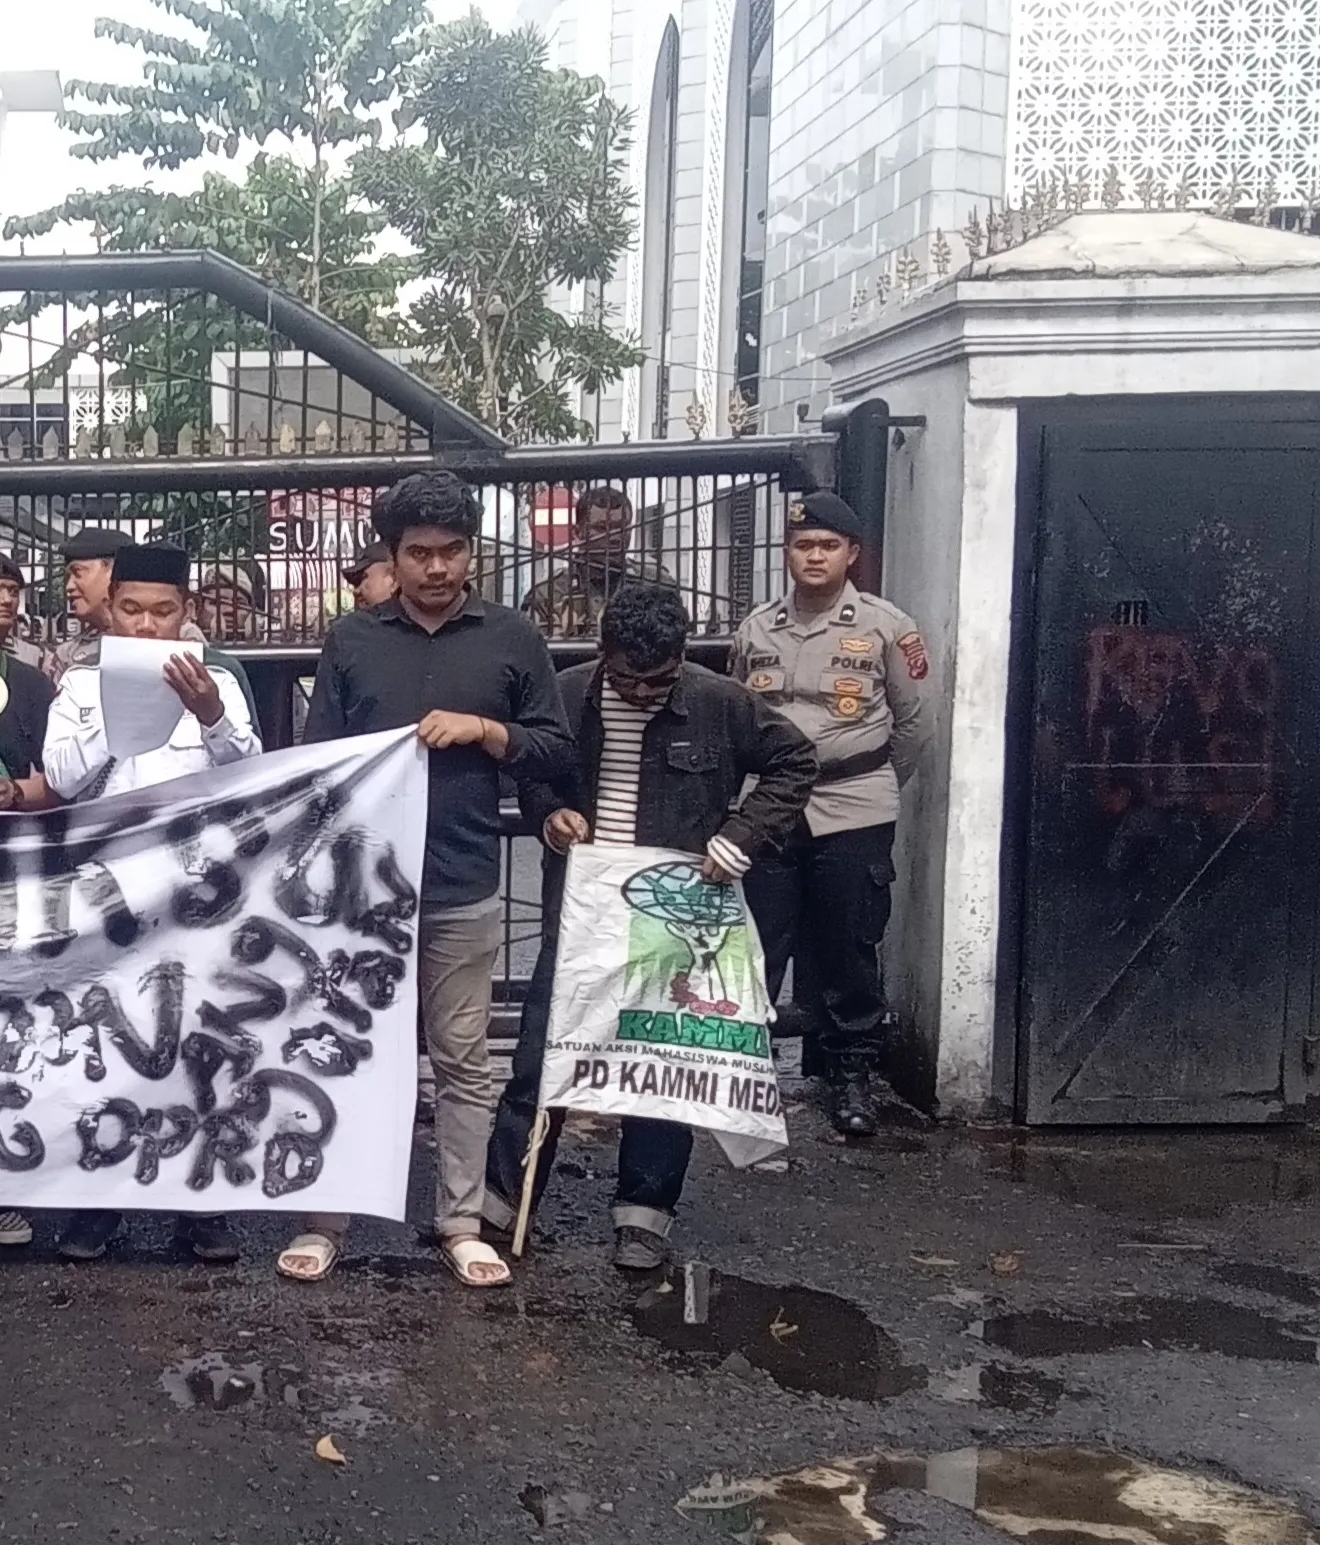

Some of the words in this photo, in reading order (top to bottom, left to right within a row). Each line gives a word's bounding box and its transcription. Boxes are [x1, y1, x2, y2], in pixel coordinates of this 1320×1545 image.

[830, 655, 873, 672] POLRI
[572, 1059, 610, 1090] PD
[618, 1060, 720, 1105] KAMMI
